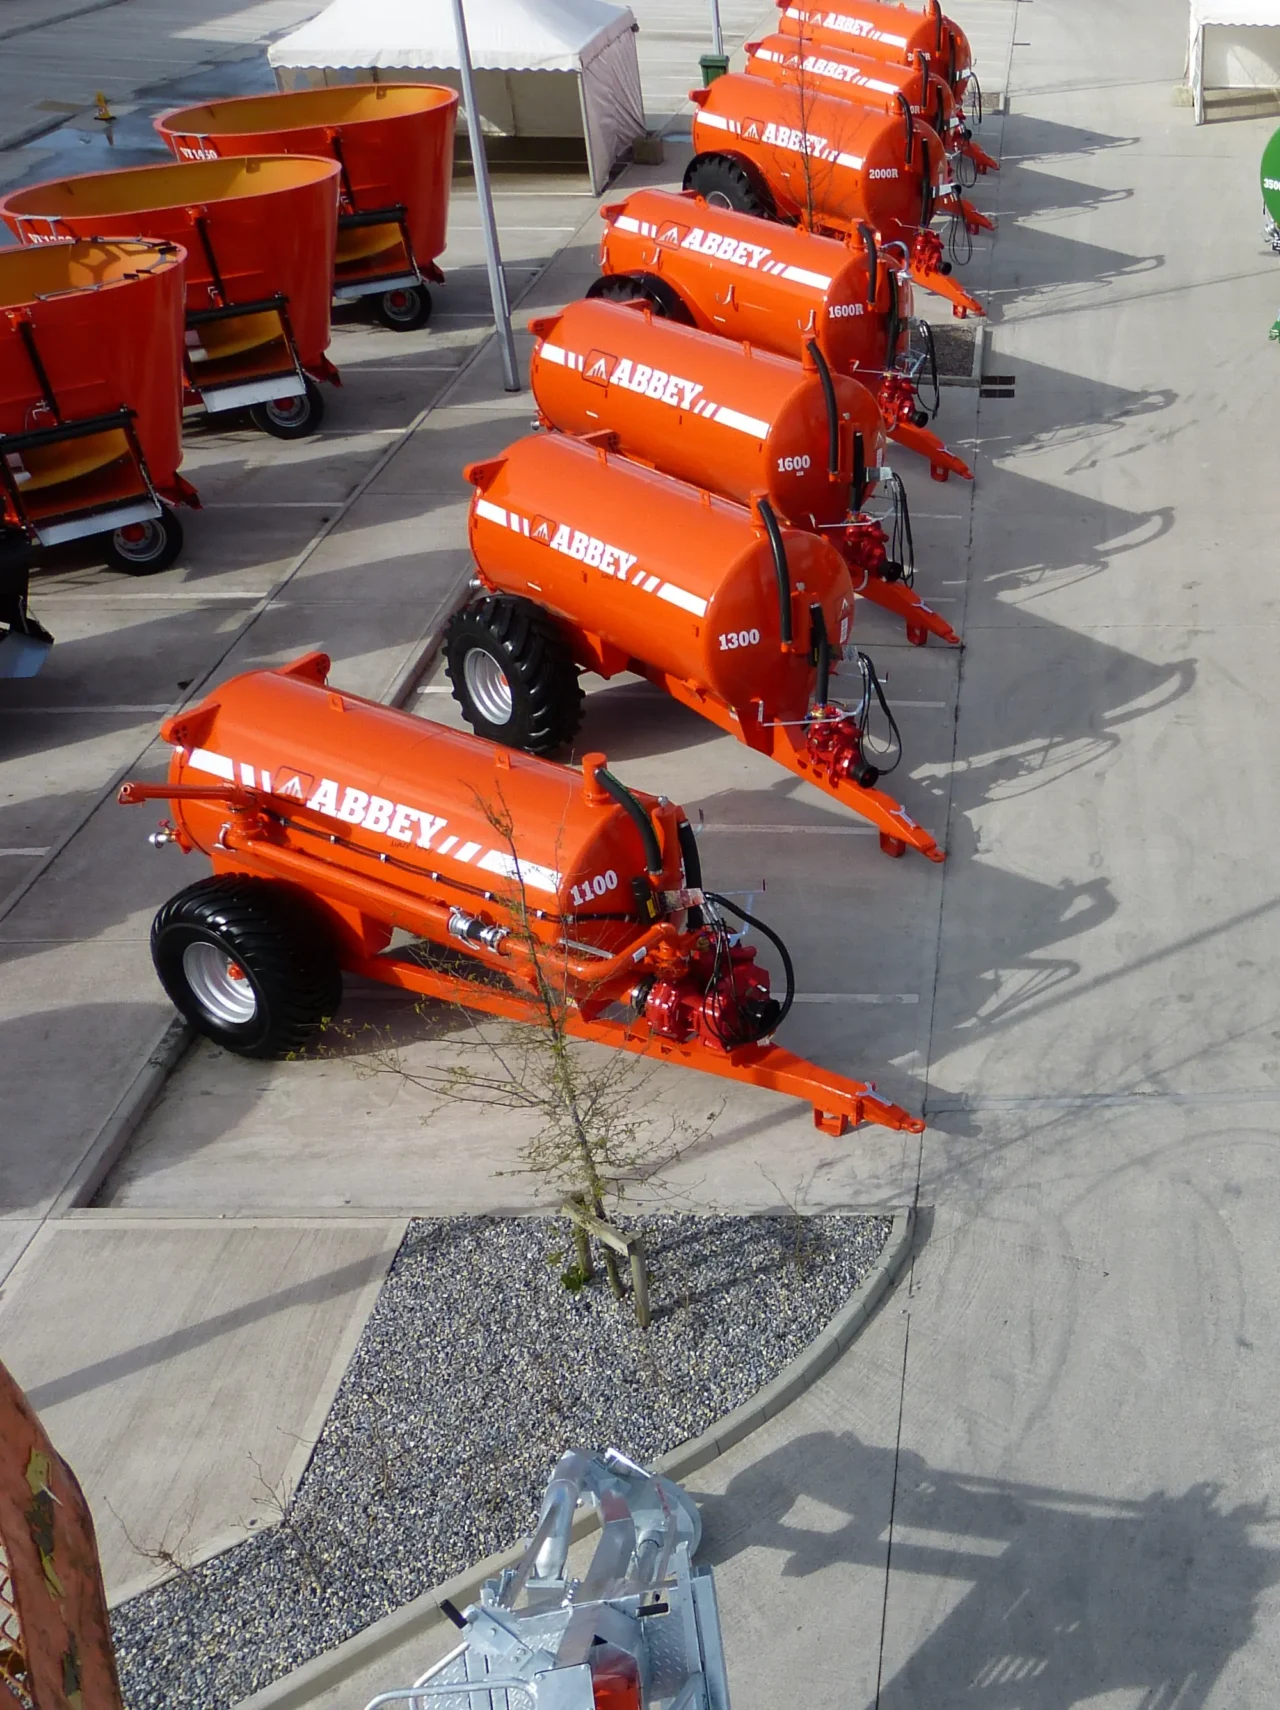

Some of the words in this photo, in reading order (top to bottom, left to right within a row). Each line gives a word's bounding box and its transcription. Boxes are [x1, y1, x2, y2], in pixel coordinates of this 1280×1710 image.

[823, 12, 874, 37] ABBEY
[800, 56, 860, 82] ABBEY
[761, 123, 828, 157] ABBEY
[869, 168, 899, 179] 2000R
[680, 228, 772, 268] ABBEY
[828, 303, 864, 318] 1600R
[610, 358, 703, 411] ABBEY
[777, 455, 811, 472] 1600
[550, 523, 637, 580] ABBEY
[718, 628, 760, 650] 1300
[306, 778, 448, 849] ABBEY
[570, 870, 618, 906] 1100
